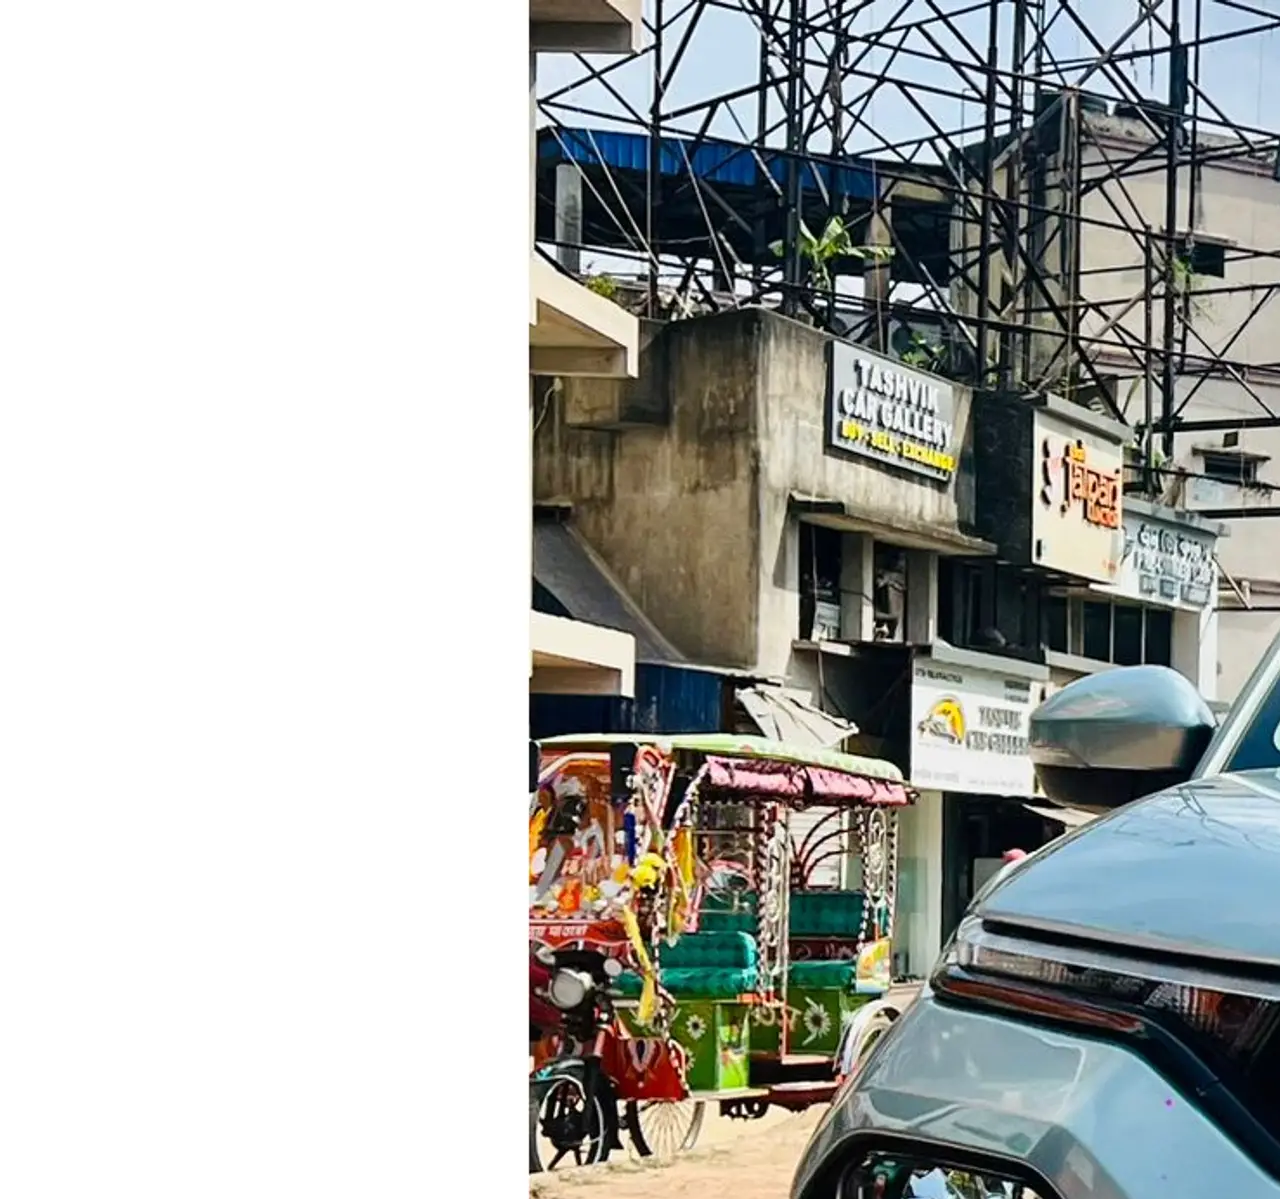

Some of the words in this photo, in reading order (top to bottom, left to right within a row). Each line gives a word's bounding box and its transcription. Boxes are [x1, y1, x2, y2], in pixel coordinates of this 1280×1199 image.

[857, 359, 941, 413] TASHVIK
[841, 388, 877, 425] CAR
[879, 402, 953, 448] GALLERY
